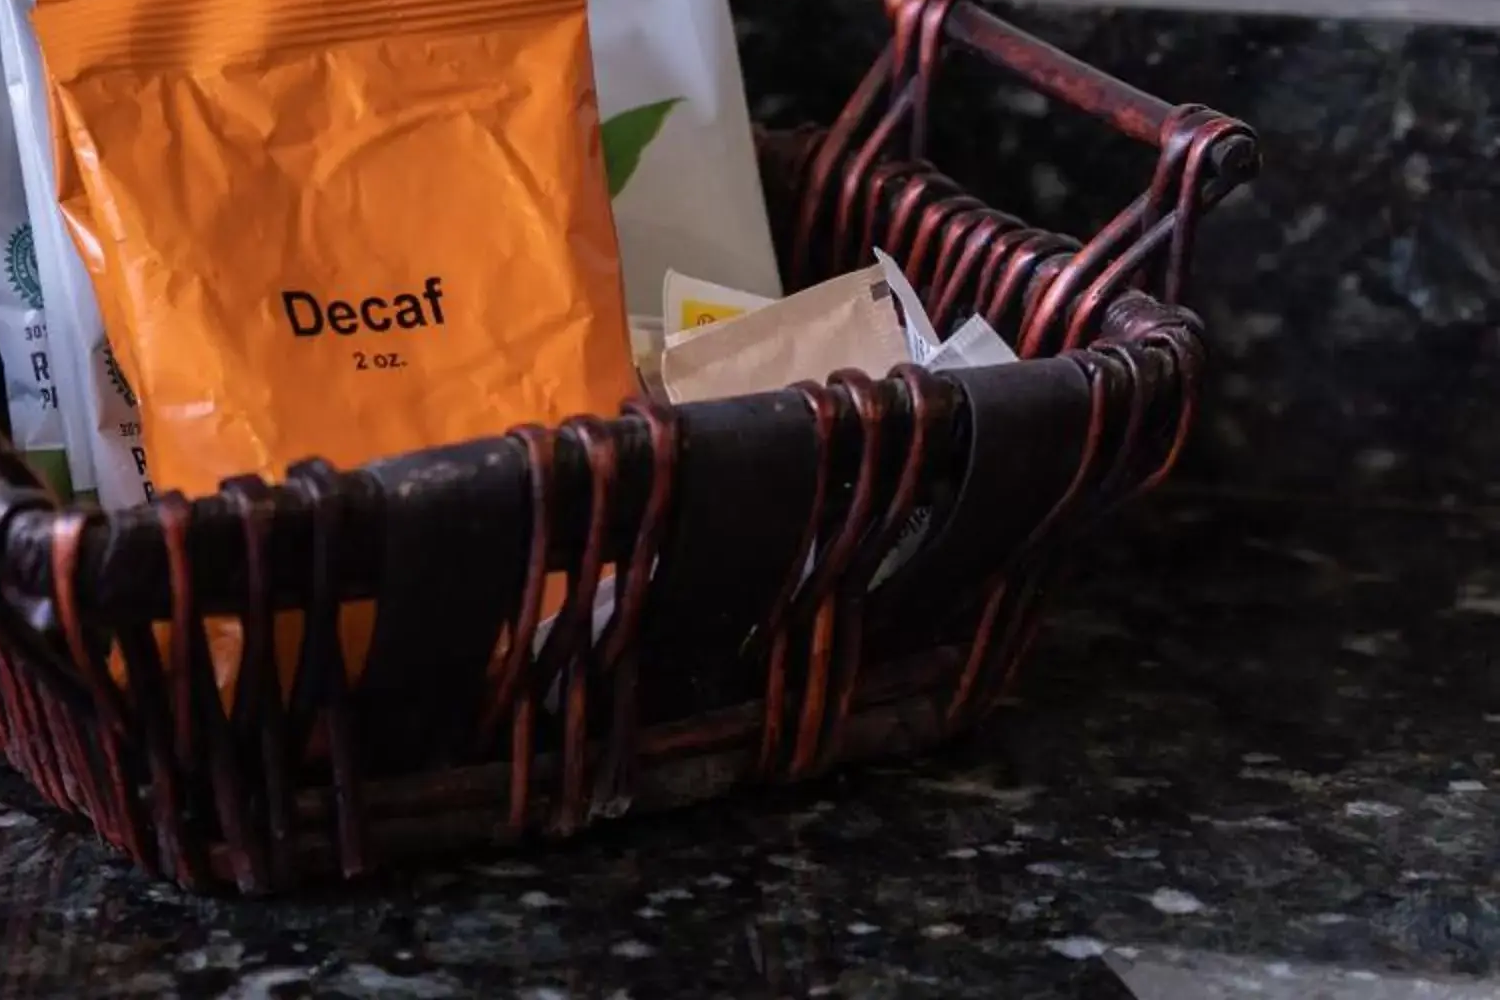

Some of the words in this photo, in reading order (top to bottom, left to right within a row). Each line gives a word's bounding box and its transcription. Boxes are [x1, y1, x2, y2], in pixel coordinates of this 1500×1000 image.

[282, 276, 445, 338] Decaf
[353, 351, 369, 371] 2
[373, 353, 408, 370] oz.
